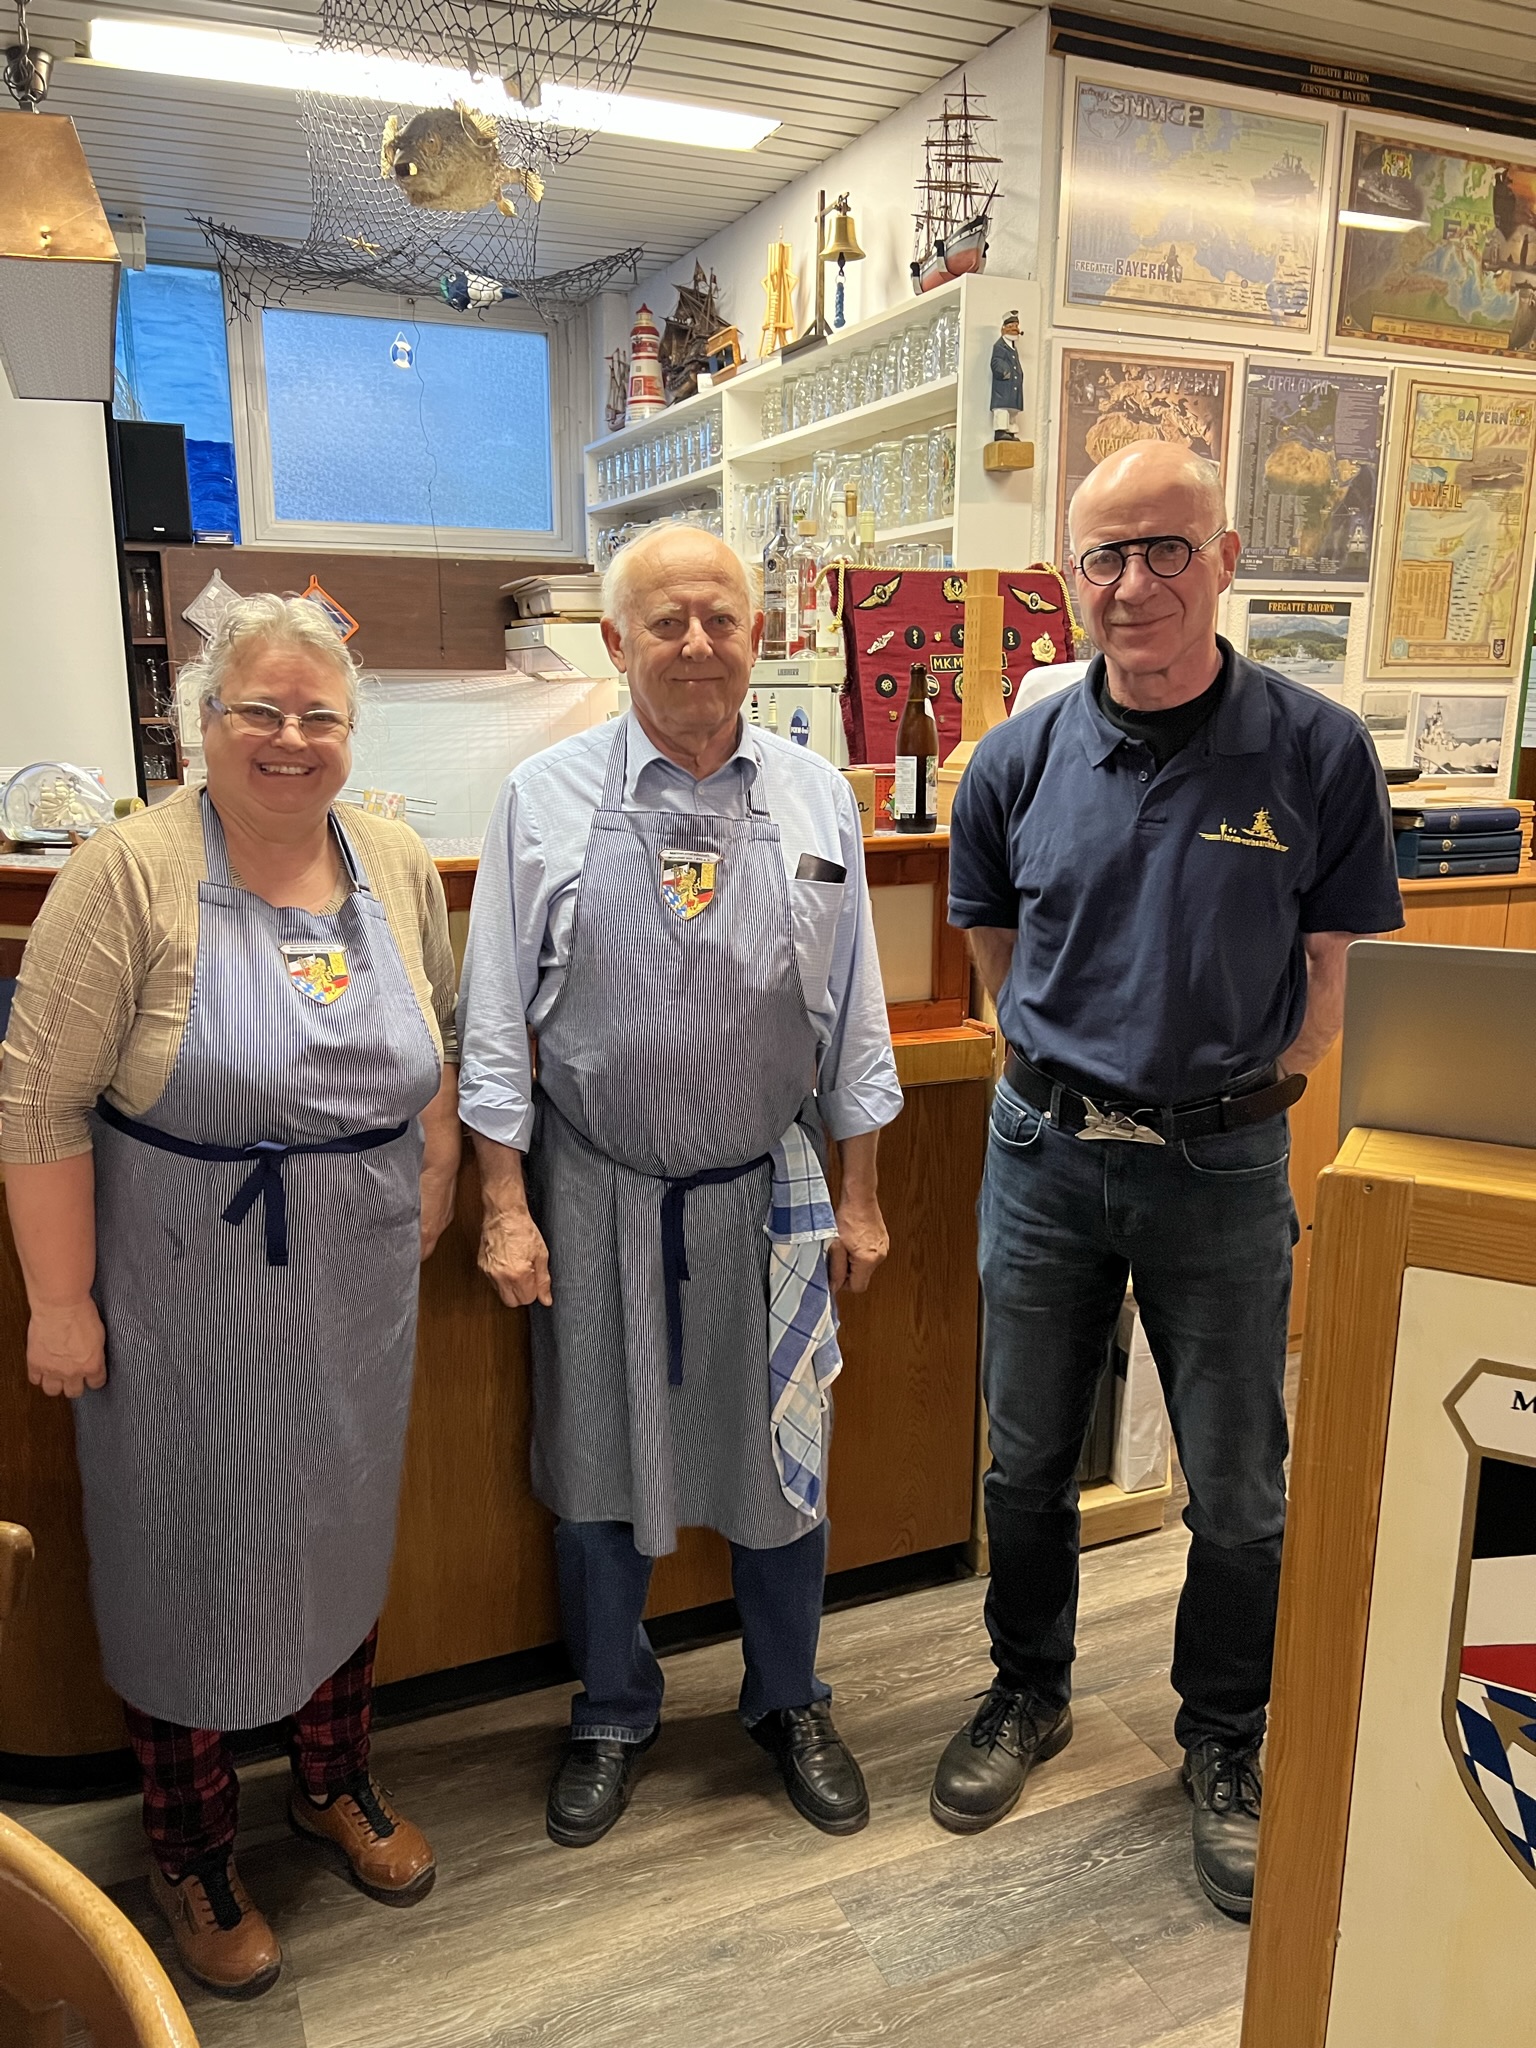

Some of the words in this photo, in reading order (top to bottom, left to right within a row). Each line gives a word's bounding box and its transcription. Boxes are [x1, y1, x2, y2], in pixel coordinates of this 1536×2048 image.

[1310, 64, 1341, 79] FREGATTE
[1344, 70, 1370, 83] BAYERN
[1343, 90, 1370, 103] BAYERN
[1075, 260, 1114, 275] FREGATTE
[1115, 258, 1166, 281] BAYERN
[1143, 369, 1219, 397] BAYERN
[1267, 375, 1329, 396] ATALANTA
[1457, 409, 1509, 425] BAYERN
[1409, 481, 1463, 508] UNIFIL
[1268, 602, 1306, 612] FREGATTE
[1307, 603, 1335, 613] BAYERN
[1510, 1389, 1536, 1414] M
